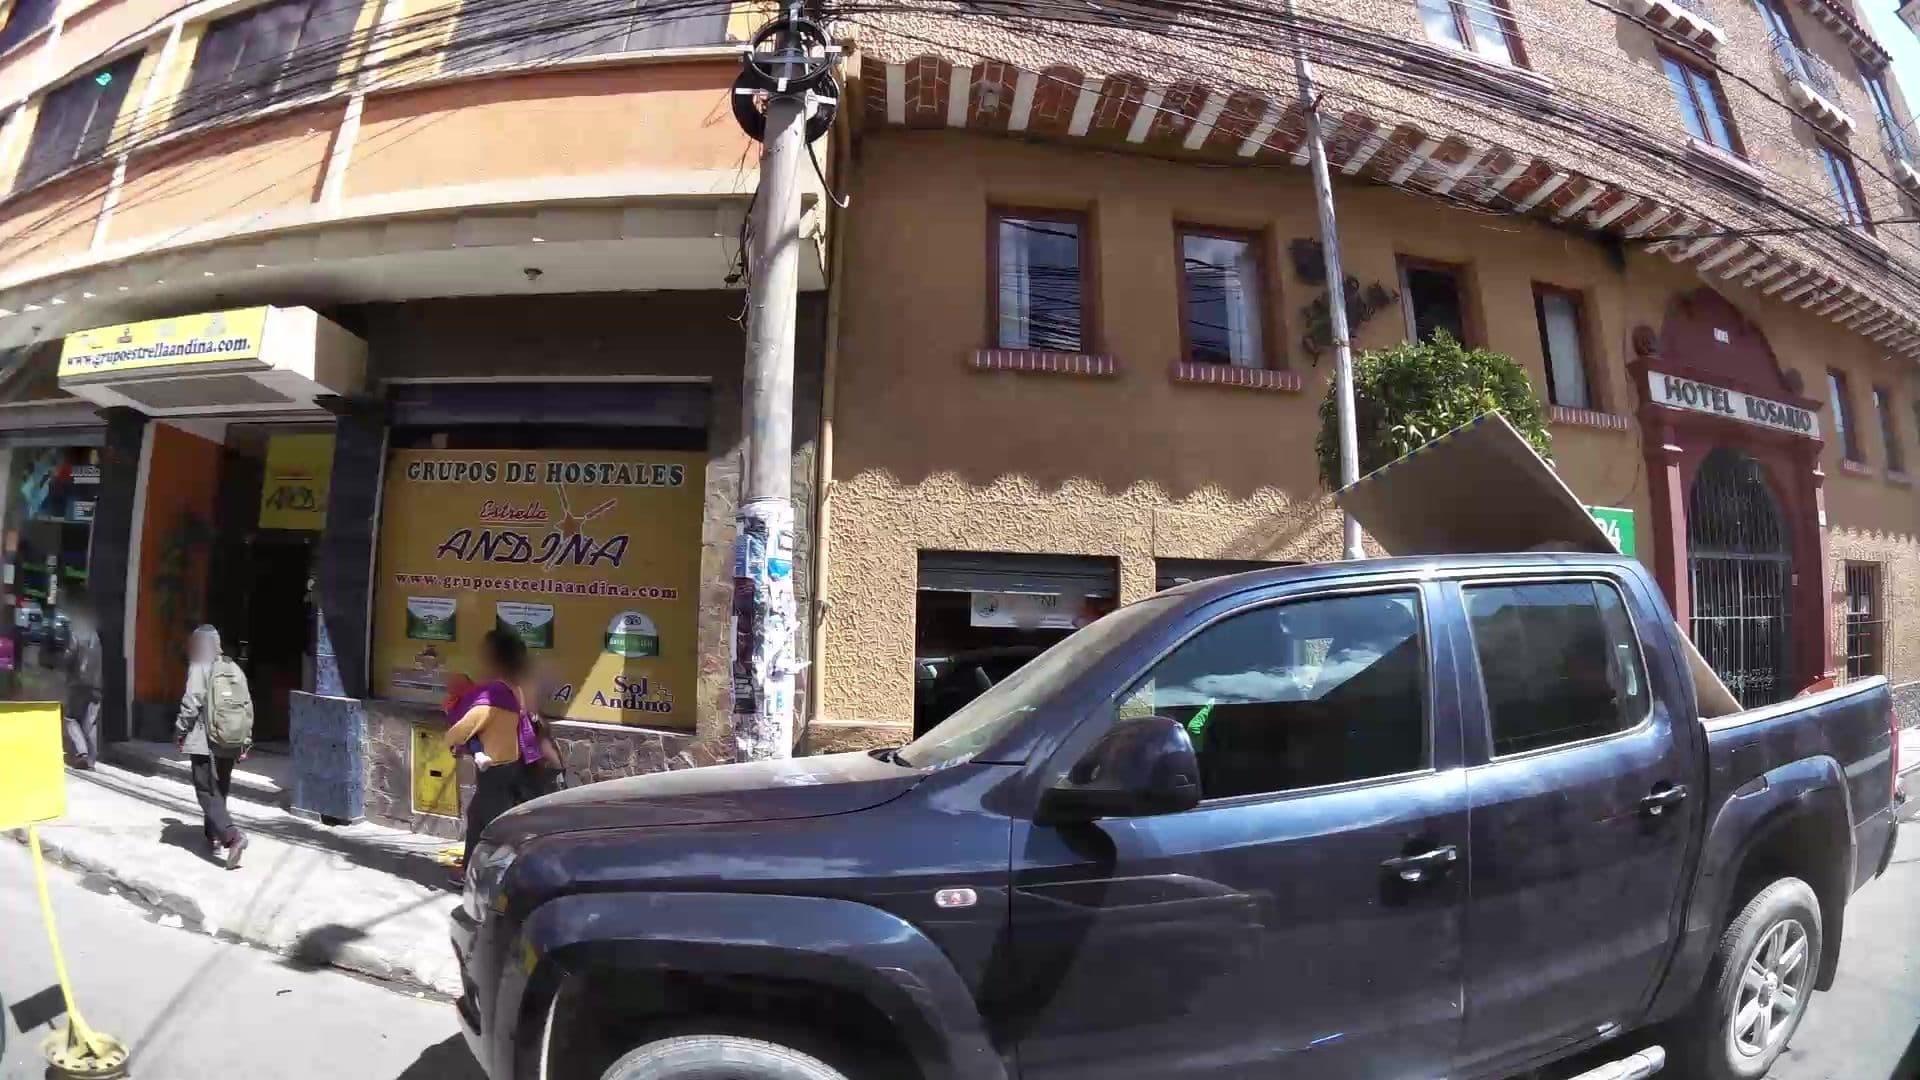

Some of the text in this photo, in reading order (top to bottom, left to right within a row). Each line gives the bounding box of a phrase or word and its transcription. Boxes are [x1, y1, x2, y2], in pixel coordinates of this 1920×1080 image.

[1664, 375, 1812, 432] HOTEL ROSARIO
[407, 461, 685, 486] GRUPOS DE HOSTALES
[479, 499, 549, 521] Estrella
[436, 528, 630, 568] ANDINA
[395, 572, 679, 600] www.grupoestrellaandina.com
[613, 675, 648, 697] Sol
[590, 690, 673, 713] Andino
